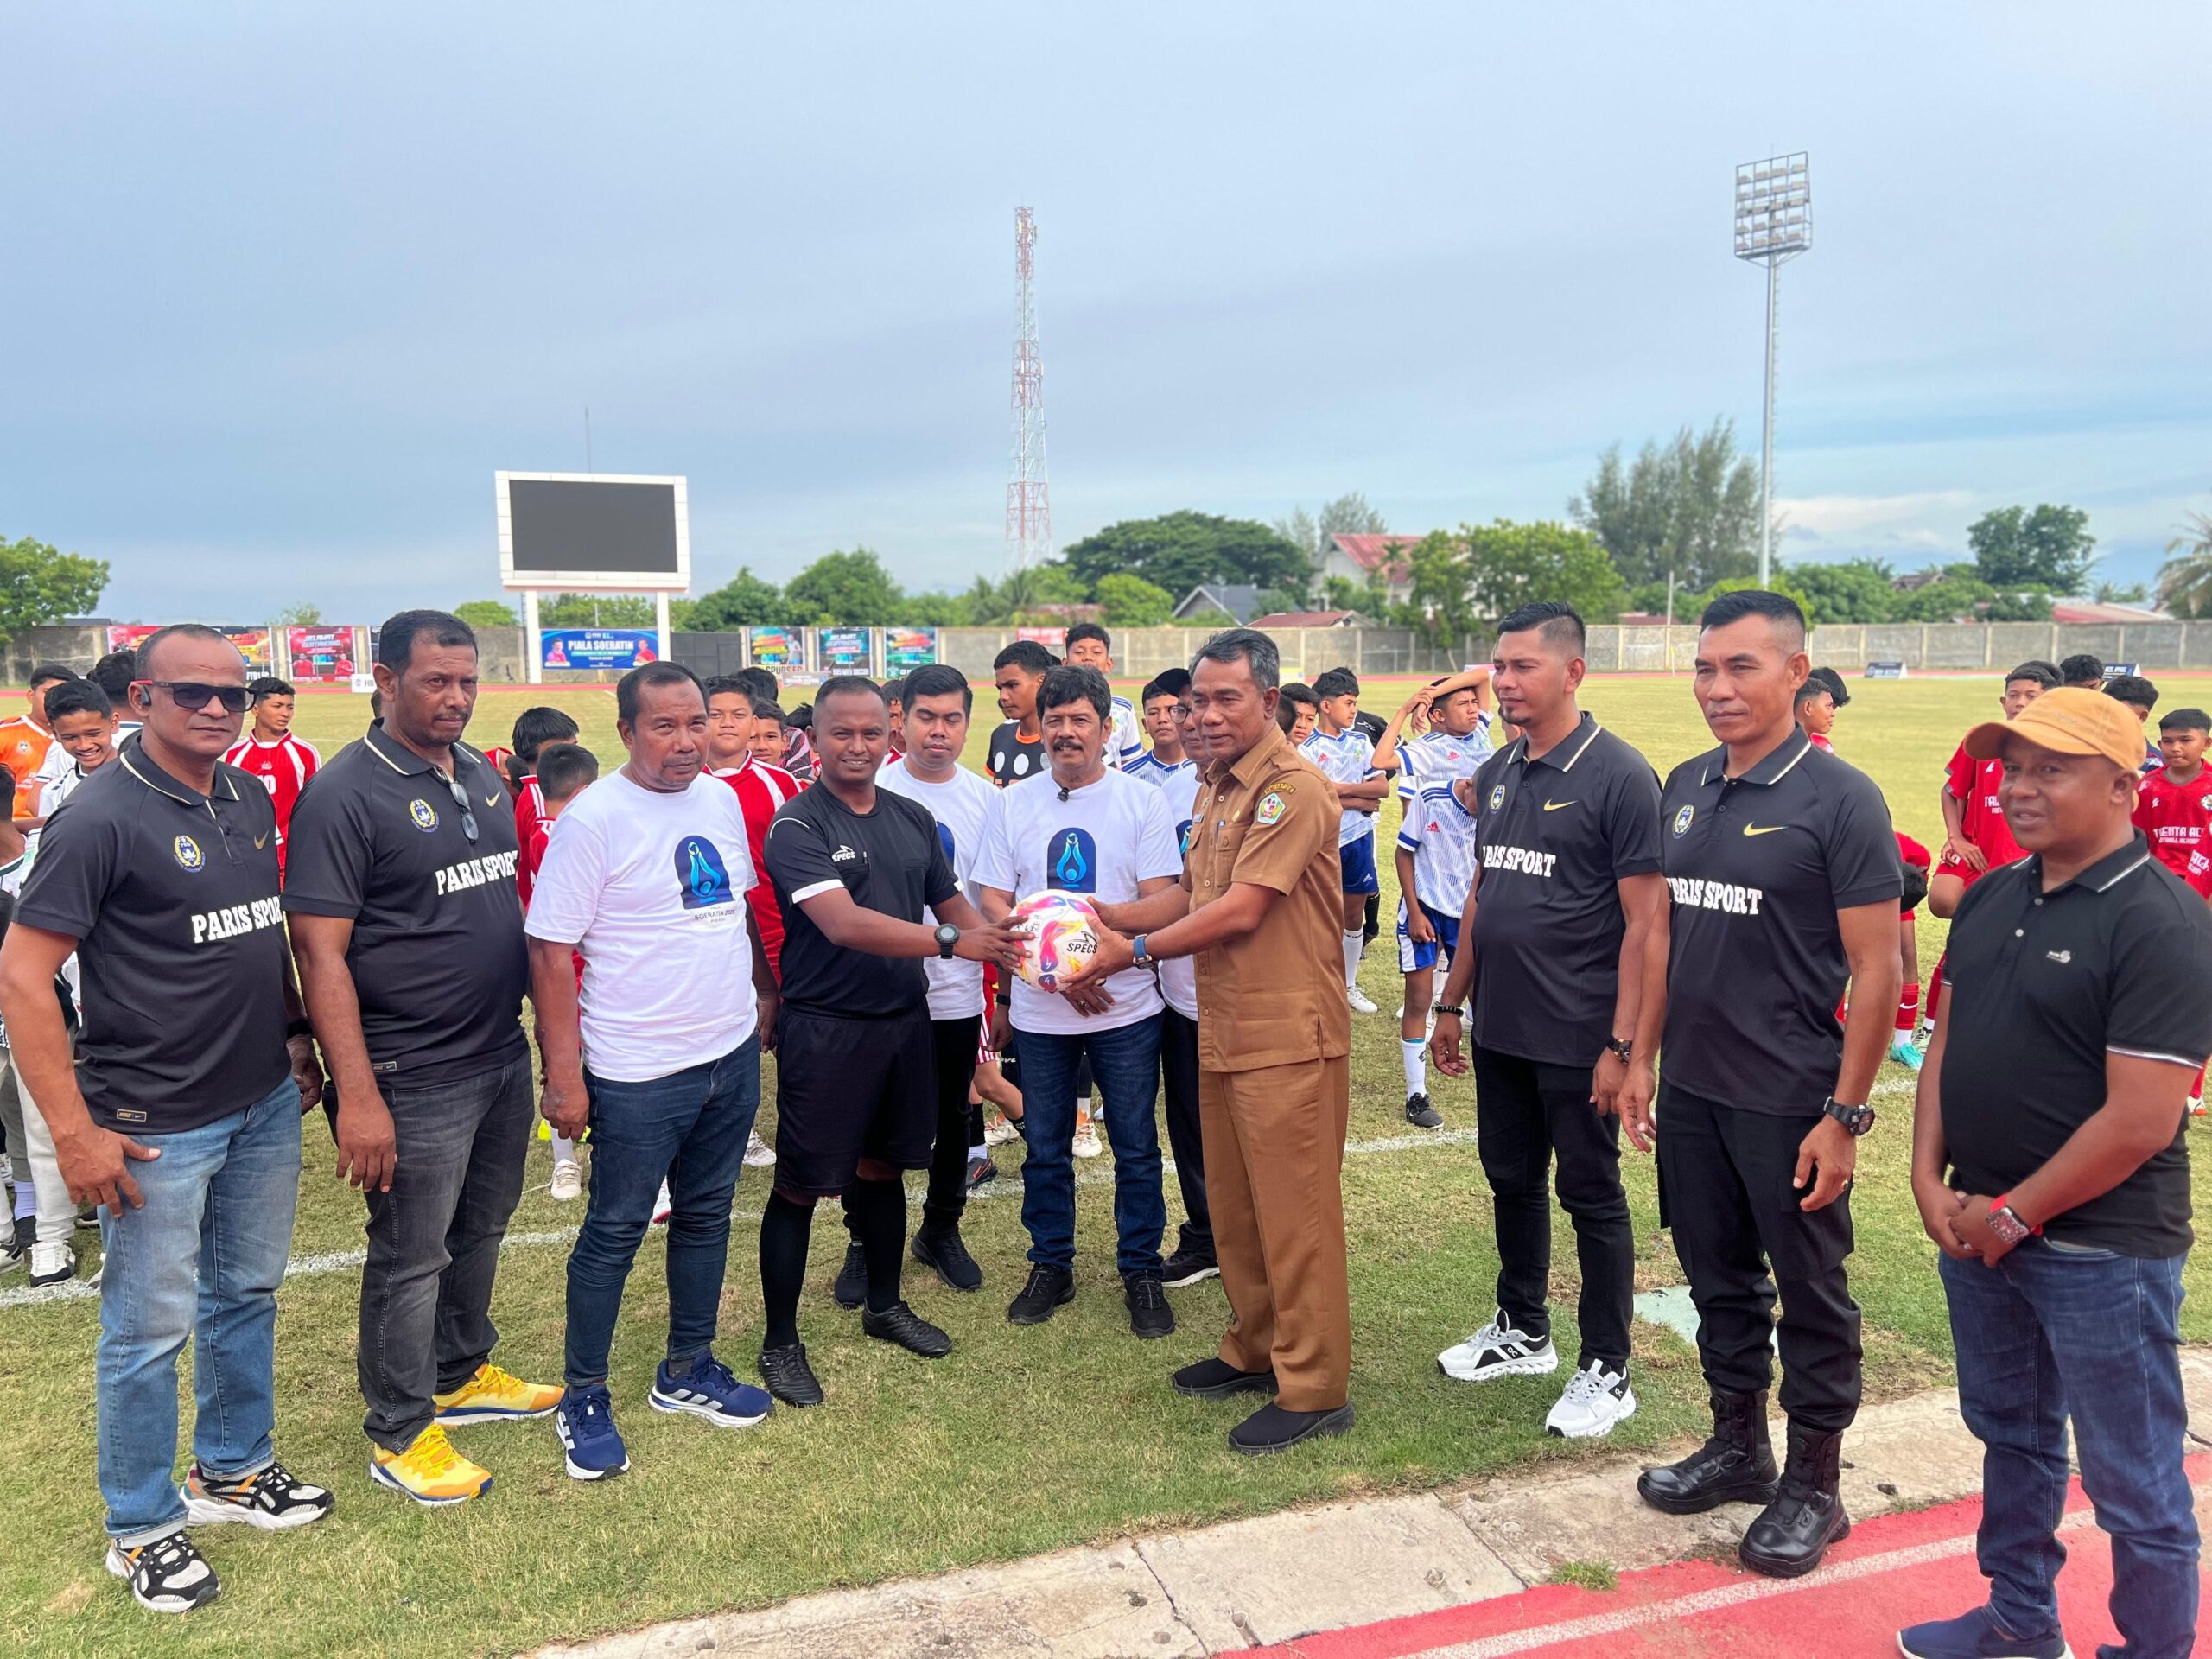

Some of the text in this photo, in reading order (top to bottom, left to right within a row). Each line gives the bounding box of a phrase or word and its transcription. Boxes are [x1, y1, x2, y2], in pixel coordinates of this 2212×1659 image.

[568, 640, 634, 651] PIALA SOERATIN
[832, 850, 855, 862] SPECS
[1503, 846, 1556, 878] SPORT
[435, 858, 486, 896] PARIS
[1703, 880, 1763, 915] SPORT
[191, 895, 283, 944] PARIS SPOR
[694, 911, 724, 920] SOERATIN
[1067, 942, 1098, 954] SPECS
